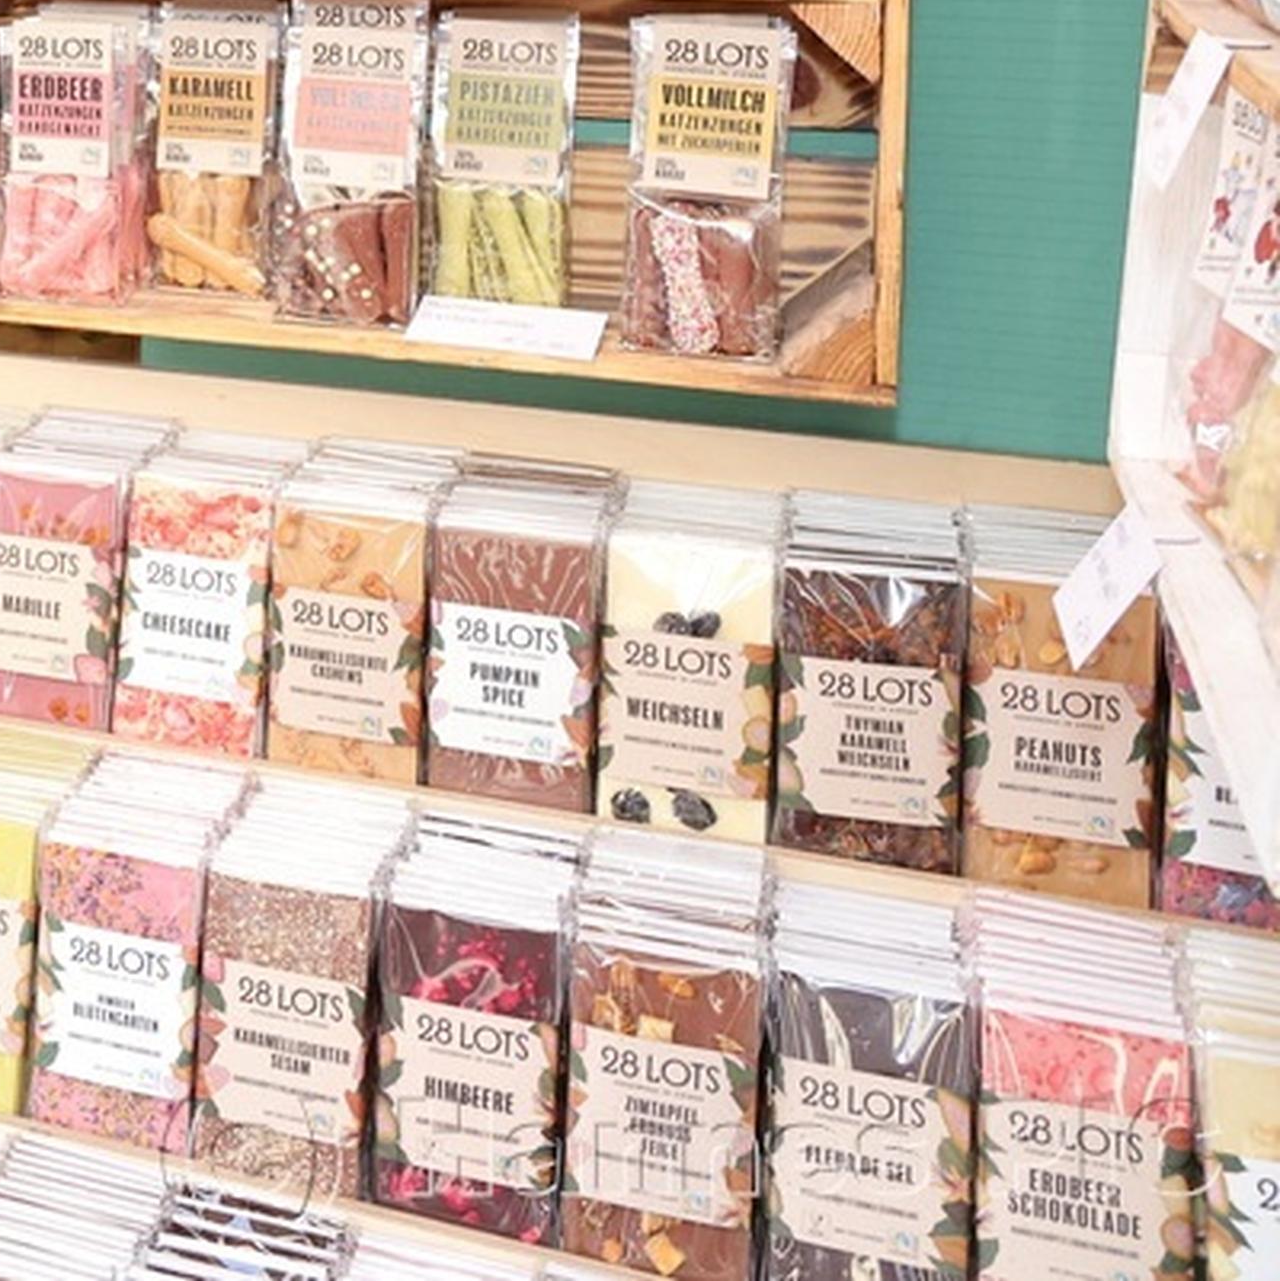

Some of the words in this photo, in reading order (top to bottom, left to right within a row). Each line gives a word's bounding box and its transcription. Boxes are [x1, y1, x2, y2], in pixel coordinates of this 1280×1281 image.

[315, 6, 343, 27] 28
[348, 5, 406, 29] LOTS
[19, 37, 47, 57] 28
[51, 37, 103, 59] LOTS
[170, 36, 199, 57] 28
[202, 36, 257, 61] LOTS
[312, 43, 343, 66] 28
[347, 43, 404, 70] LOTS
[463, 39, 494, 60] 28
[498, 38, 558, 66] LOTS
[665, 41, 699, 63] 28
[704, 41, 768, 69] LOTS
[18, 75, 103, 101] ERDBEER
[169, 76, 254, 101] KARAMELL
[662, 84, 766, 113] VOLLMILCH
[659, 113, 762, 135] KATZENZUNGEN
[25, 548, 80, 578] LOTS
[146, 562, 176, 587] 28
[180, 566, 237, 597] LOTS
[2, 595, 62, 621] MARILLE
[292, 599, 323, 626] 28
[329, 605, 388, 637] LOTS
[142, 611, 231, 645] CHEESECAKE
[456, 618, 488, 644] 28
[495, 623, 559, 655] LOTS
[469, 662, 540, 688] PUMPKIN
[624, 641, 660, 669] 28
[665, 647, 732, 679] LOTS
[482, 684, 525, 708] SPICE
[818, 671, 855, 698] 28
[863, 674, 933, 707] LOTS
[1000, 683, 1037, 711] 28
[1046, 687, 1121, 722] LOTS
[626, 698, 724, 730] WEICHSELN
[845, 715, 904, 735] THYMIAN
[840, 732, 908, 755] KARAMELL
[1015, 736, 1102, 767] PEANUTS
[838, 748, 910, 772] WEICHSELN
[70, 936, 101, 965] 28
[107, 945, 170, 980] LOTS
[239, 976, 272, 1007] 28
[277, 985, 343, 1022] LOTS
[417, 1014, 451, 1046] 28
[459, 1022, 529, 1061] LOTS
[271, 1053, 310, 1075] SESAM
[601, 1045, 638, 1079] 28
[646, 1056, 720, 1095] LOTS
[424, 1075, 514, 1115] HIMBEERE
[800, 1075, 838, 1111] 28
[846, 1085, 926, 1129] LOTS
[1010, 1111, 1052, 1145] 28
[1059, 1122, 1143, 1164] LOTS
[804, 1145, 856, 1175] FLEUR
[859, 1155, 880, 1178] DE
[885, 1161, 915, 1186] SEL
[1029, 1167, 1122, 1208] ERDBEER
[1007, 1192, 1142, 1241] SCHOKOLADE
